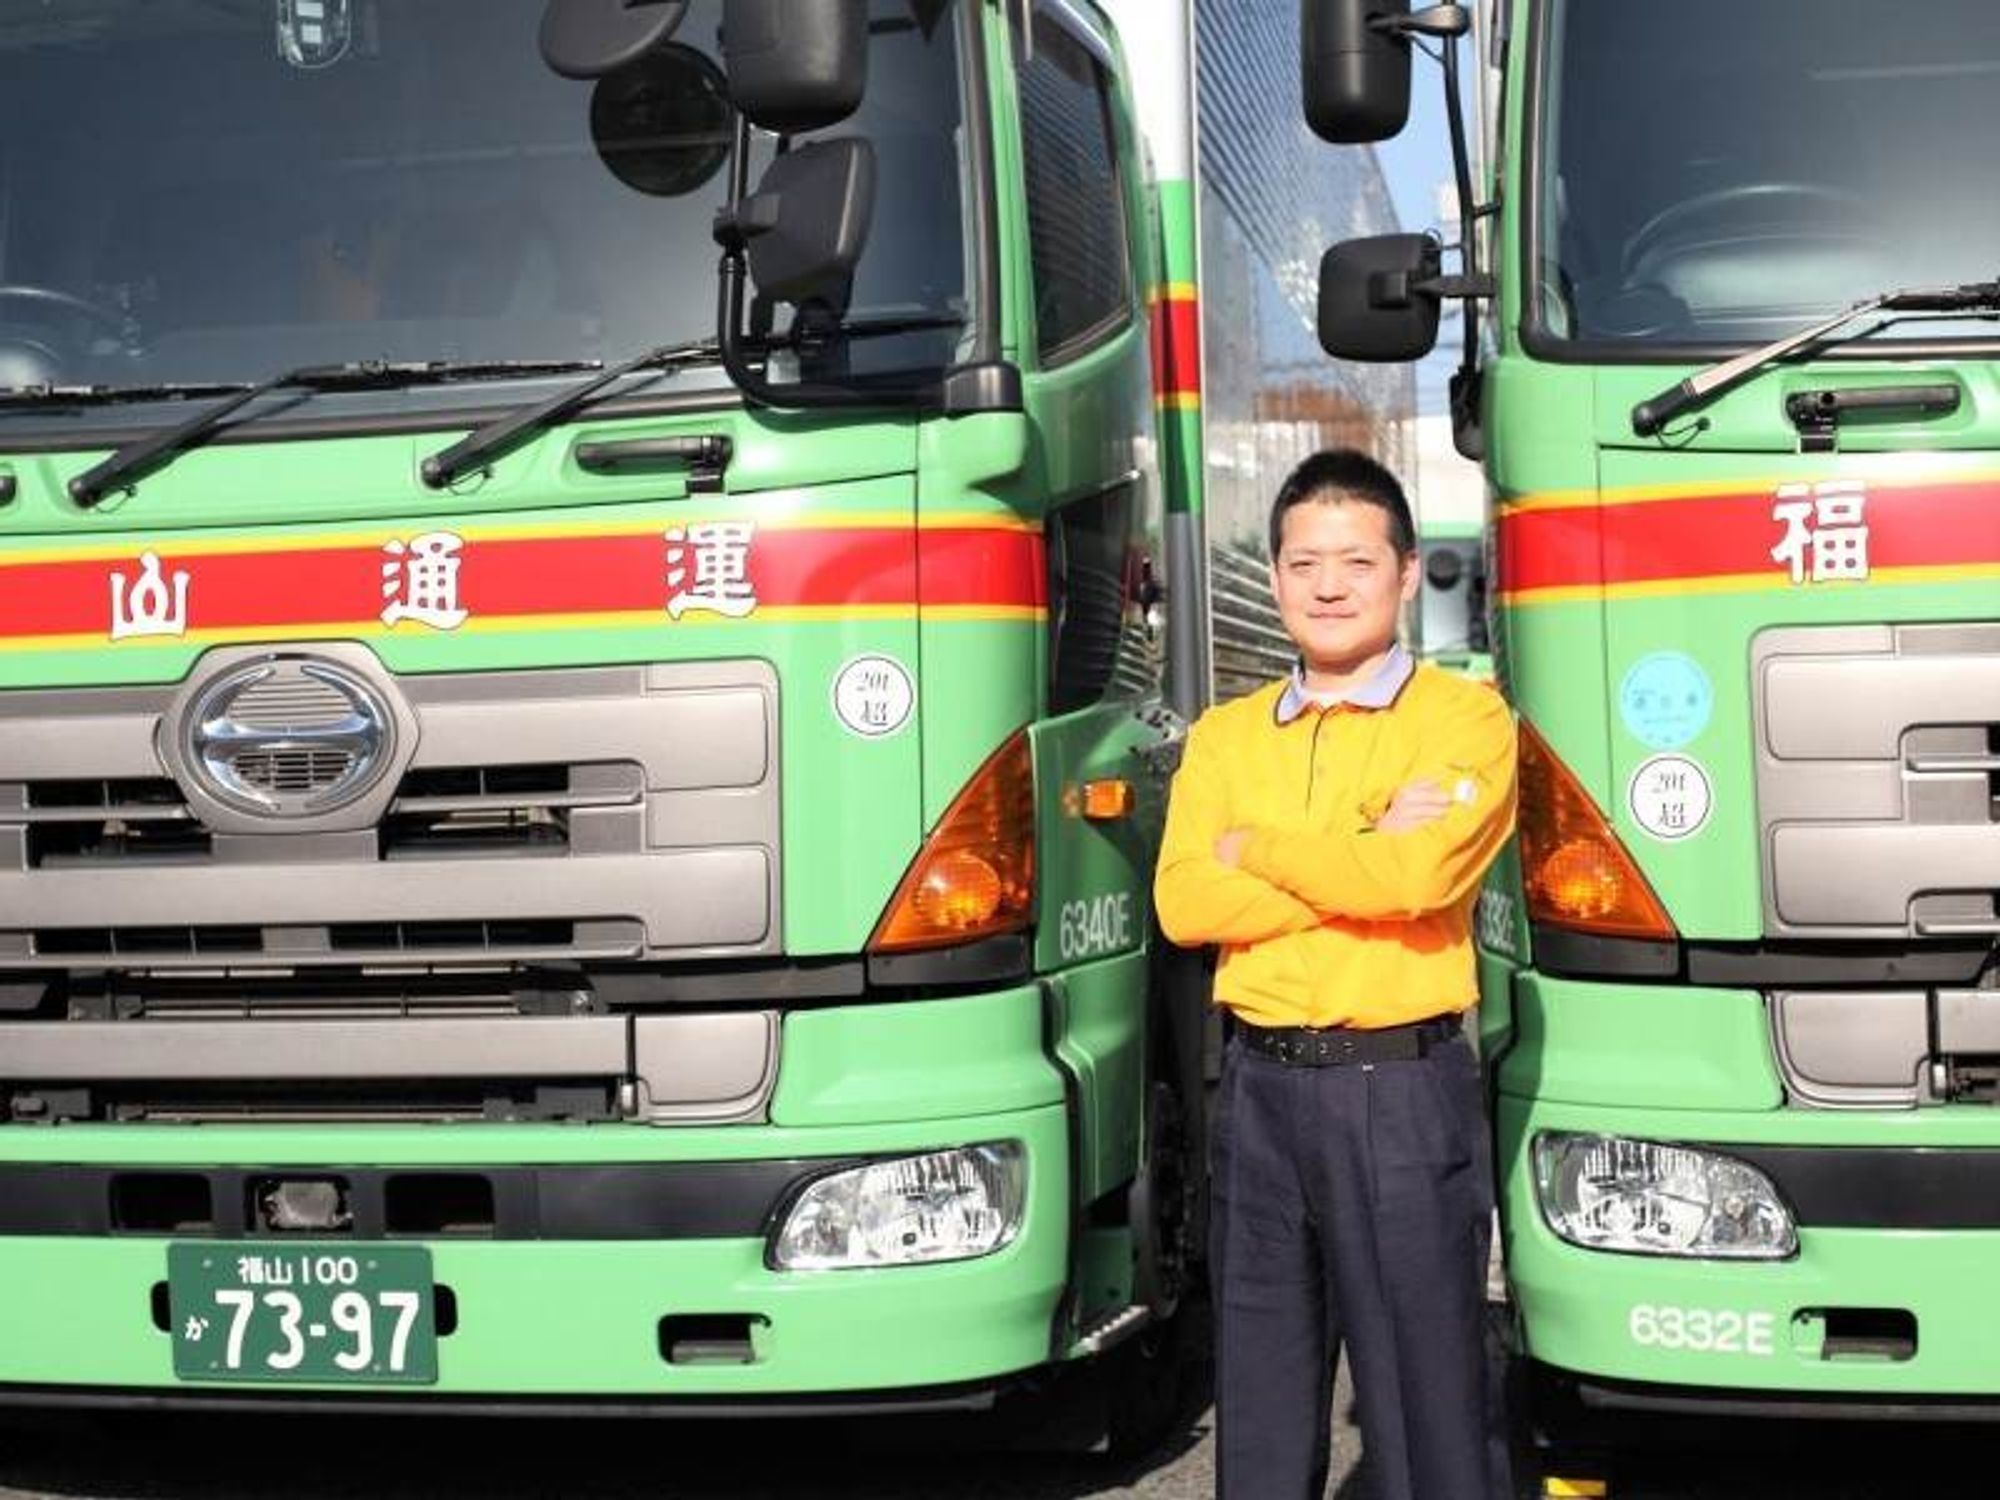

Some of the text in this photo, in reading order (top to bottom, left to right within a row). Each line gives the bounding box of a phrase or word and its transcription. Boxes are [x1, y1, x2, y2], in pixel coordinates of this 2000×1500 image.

[1769, 480, 1869, 584] 福
[1061, 892, 1130, 959] 6340E
[184, 1290, 420, 1371] か 73-97
[1630, 1304, 1775, 1354] 6332E
